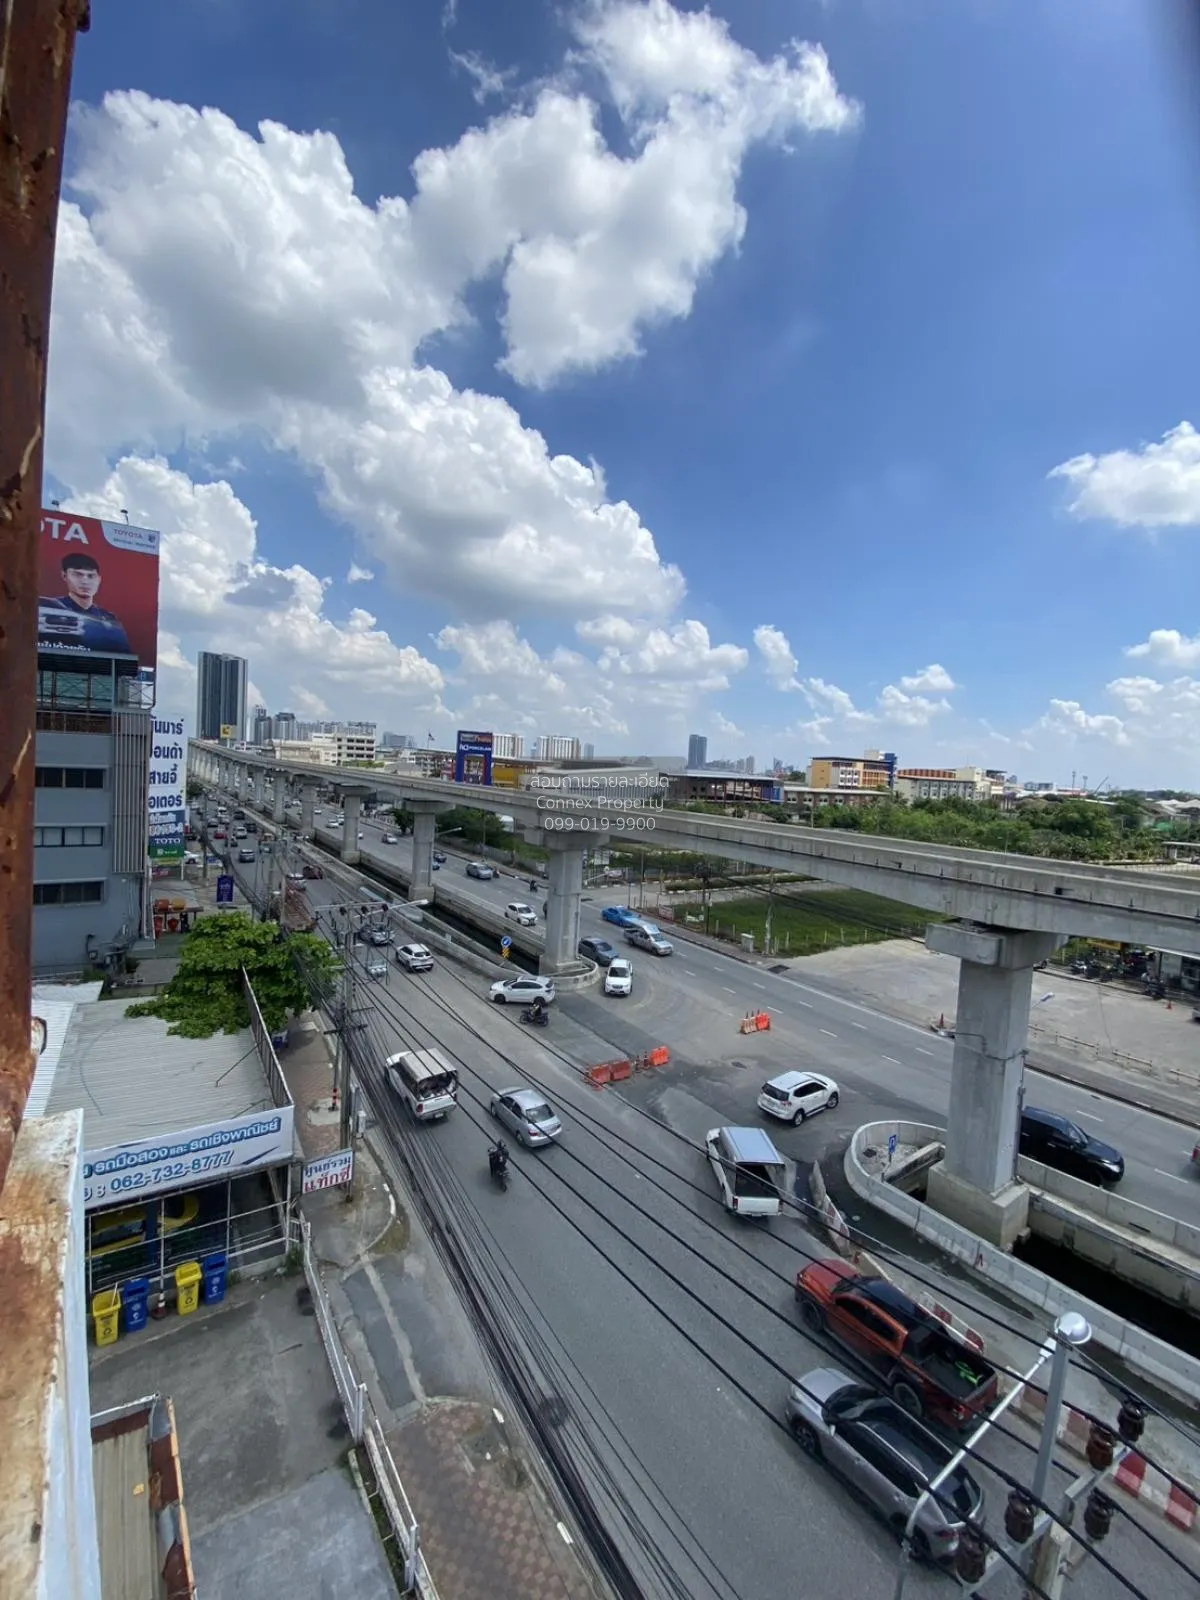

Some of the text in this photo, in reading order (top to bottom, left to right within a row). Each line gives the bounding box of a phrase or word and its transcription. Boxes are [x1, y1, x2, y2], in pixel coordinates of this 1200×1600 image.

[151, 716, 184, 735] ันมาร์
[150, 742, 183, 760] อนด้า
[154, 837, 181, 845] TOTO
[111, 1150, 233, 1191] 062-732-8777
